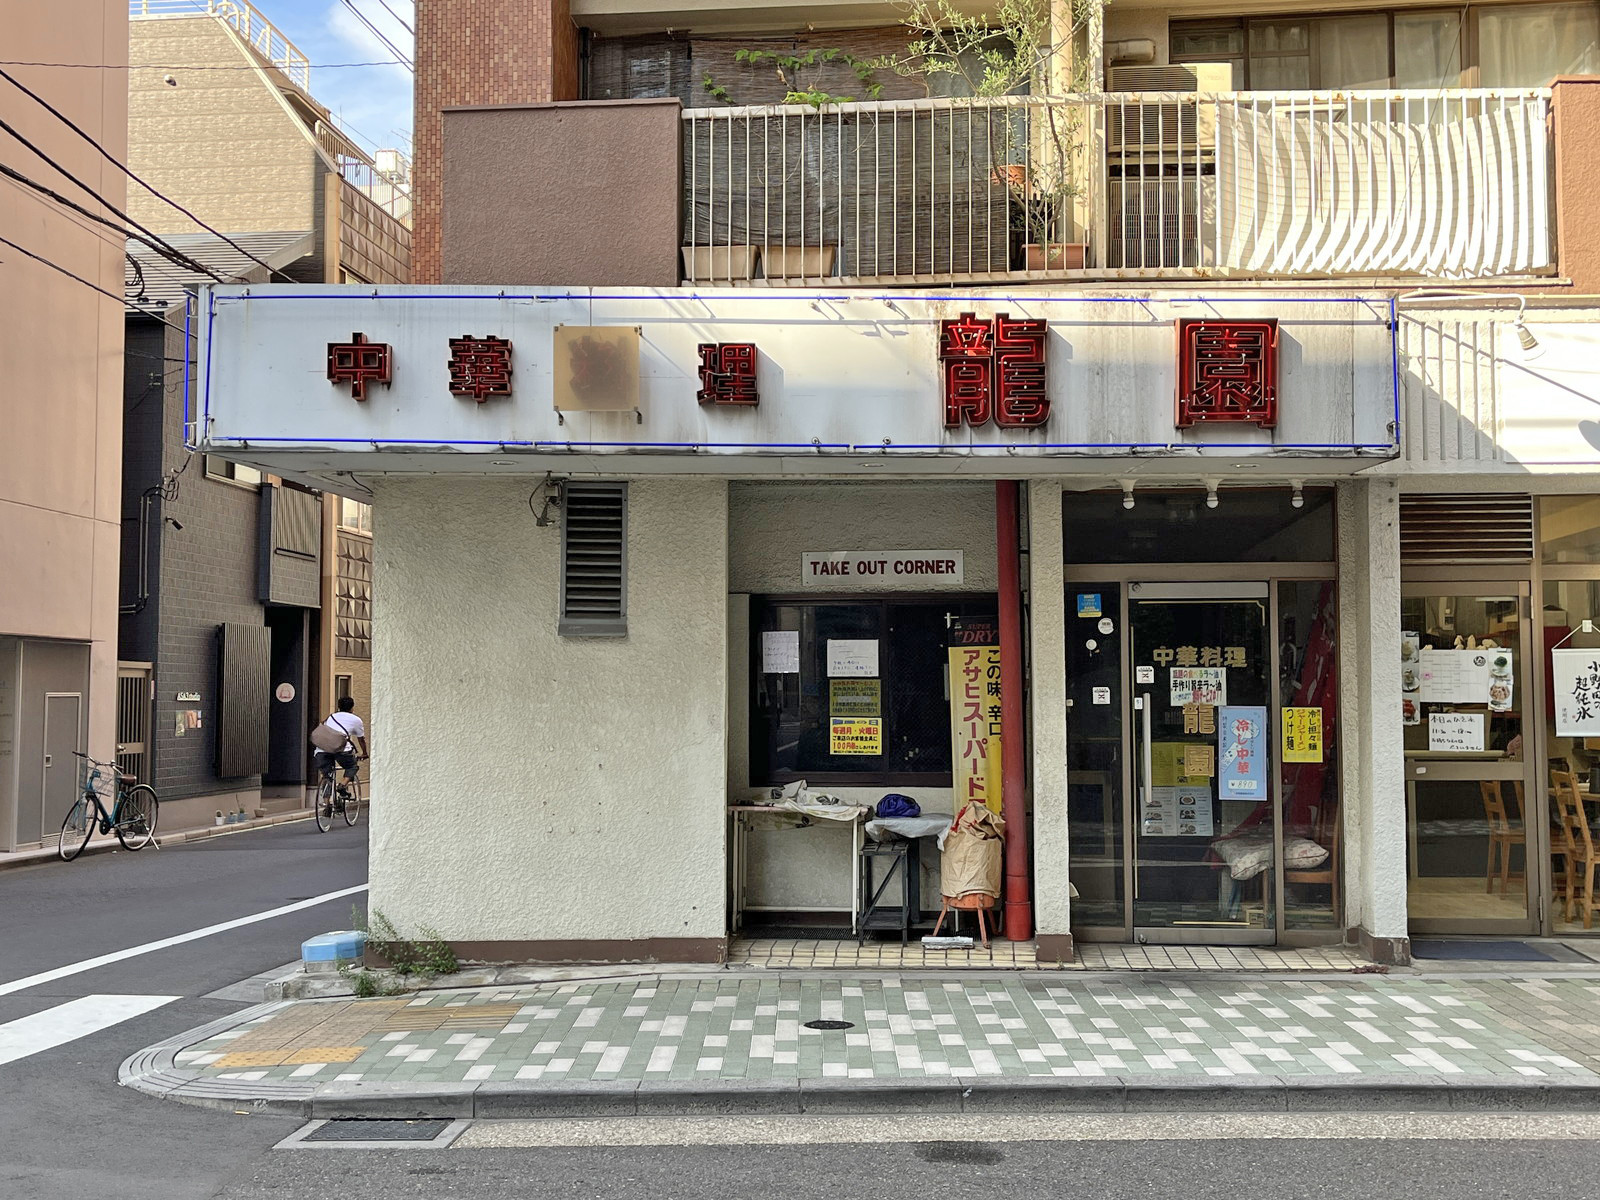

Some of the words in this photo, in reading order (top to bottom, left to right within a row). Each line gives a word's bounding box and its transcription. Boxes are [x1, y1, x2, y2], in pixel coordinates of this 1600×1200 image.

[810, 561, 850, 576] TAKE
[857, 560, 888, 575] OUT
[893, 559, 956, 575] CORNER
[1153, 645, 1248, 668] 中華料理
[1235, 719, 1250, 774] 冷し中華
[1286, 709, 1295, 751] つけ麺
[1308, 709, 1318, 751] 冷し担々麺
